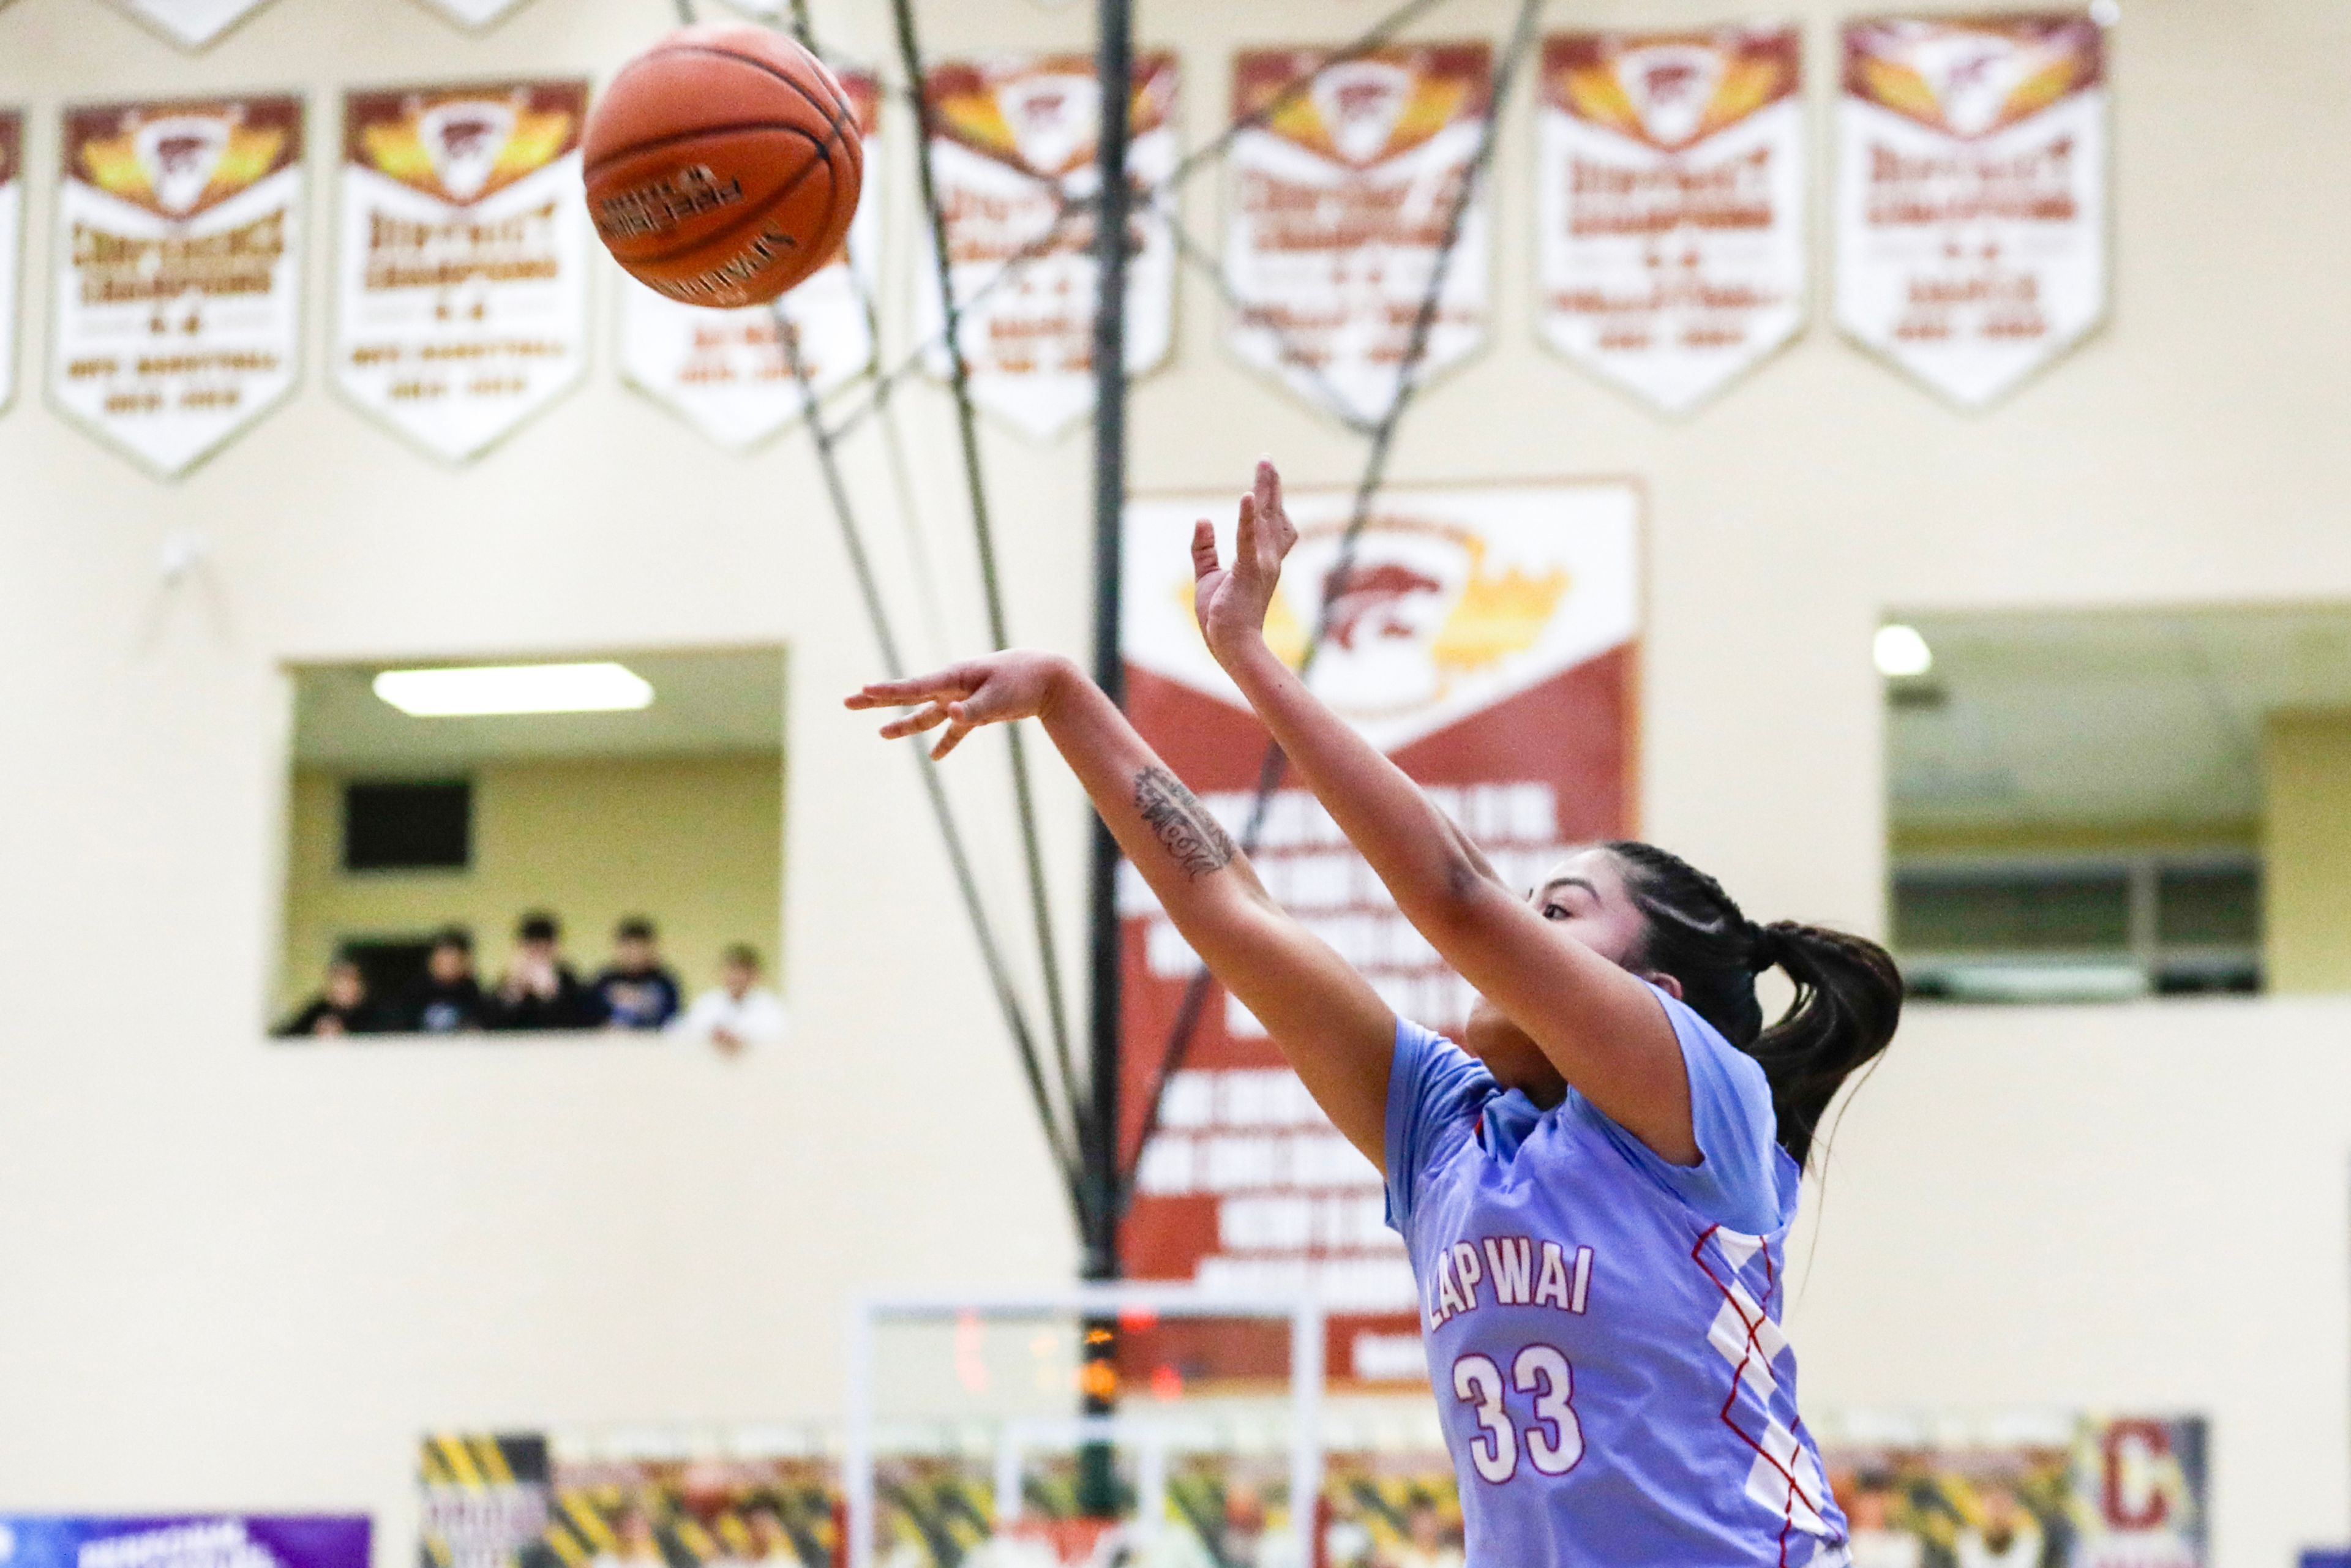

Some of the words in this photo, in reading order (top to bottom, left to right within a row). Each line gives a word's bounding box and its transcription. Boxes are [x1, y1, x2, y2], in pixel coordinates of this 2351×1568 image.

[1427, 1236, 1594, 1332] LAPWAI
[1452, 1343, 1585, 1485] 33
[2102, 1418, 2171, 1532] C
